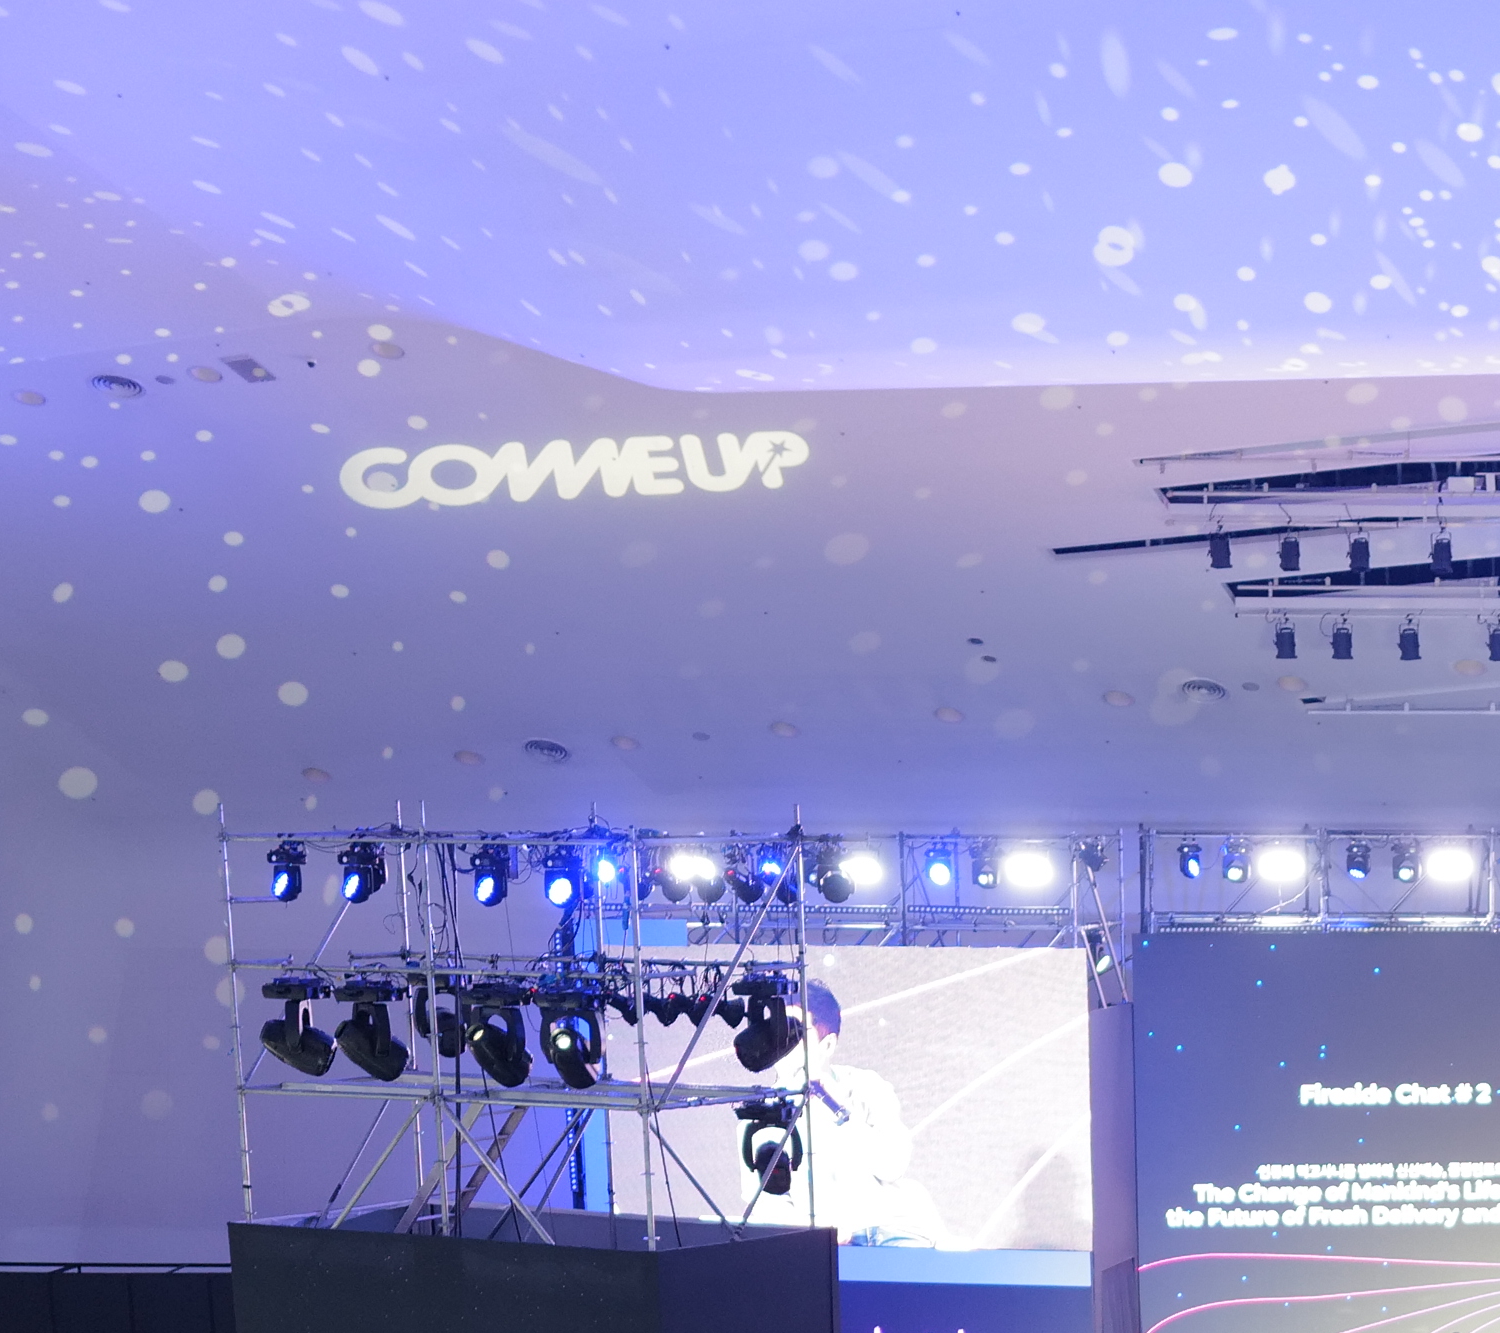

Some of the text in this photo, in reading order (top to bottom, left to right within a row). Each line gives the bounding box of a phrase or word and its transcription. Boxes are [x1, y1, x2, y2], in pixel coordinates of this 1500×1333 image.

[339, 430, 809, 509] COMEUP
[1300, 1082, 1492, 1107] Fireside Chat # 2
[1193, 1182, 1234, 1206] The
[1237, 1183, 1320, 1207] Change
[1323, 1182, 1349, 1203] of
[1352, 1180, 1459, 1203] Mankind's
[1166, 1205, 1203, 1228] the
[1207, 1205, 1279, 1228] Future
[1282, 1205, 1306, 1227] of
[1308, 1204, 1368, 1227] Fresh
[1371, 1203, 1458, 1229] Delivery
